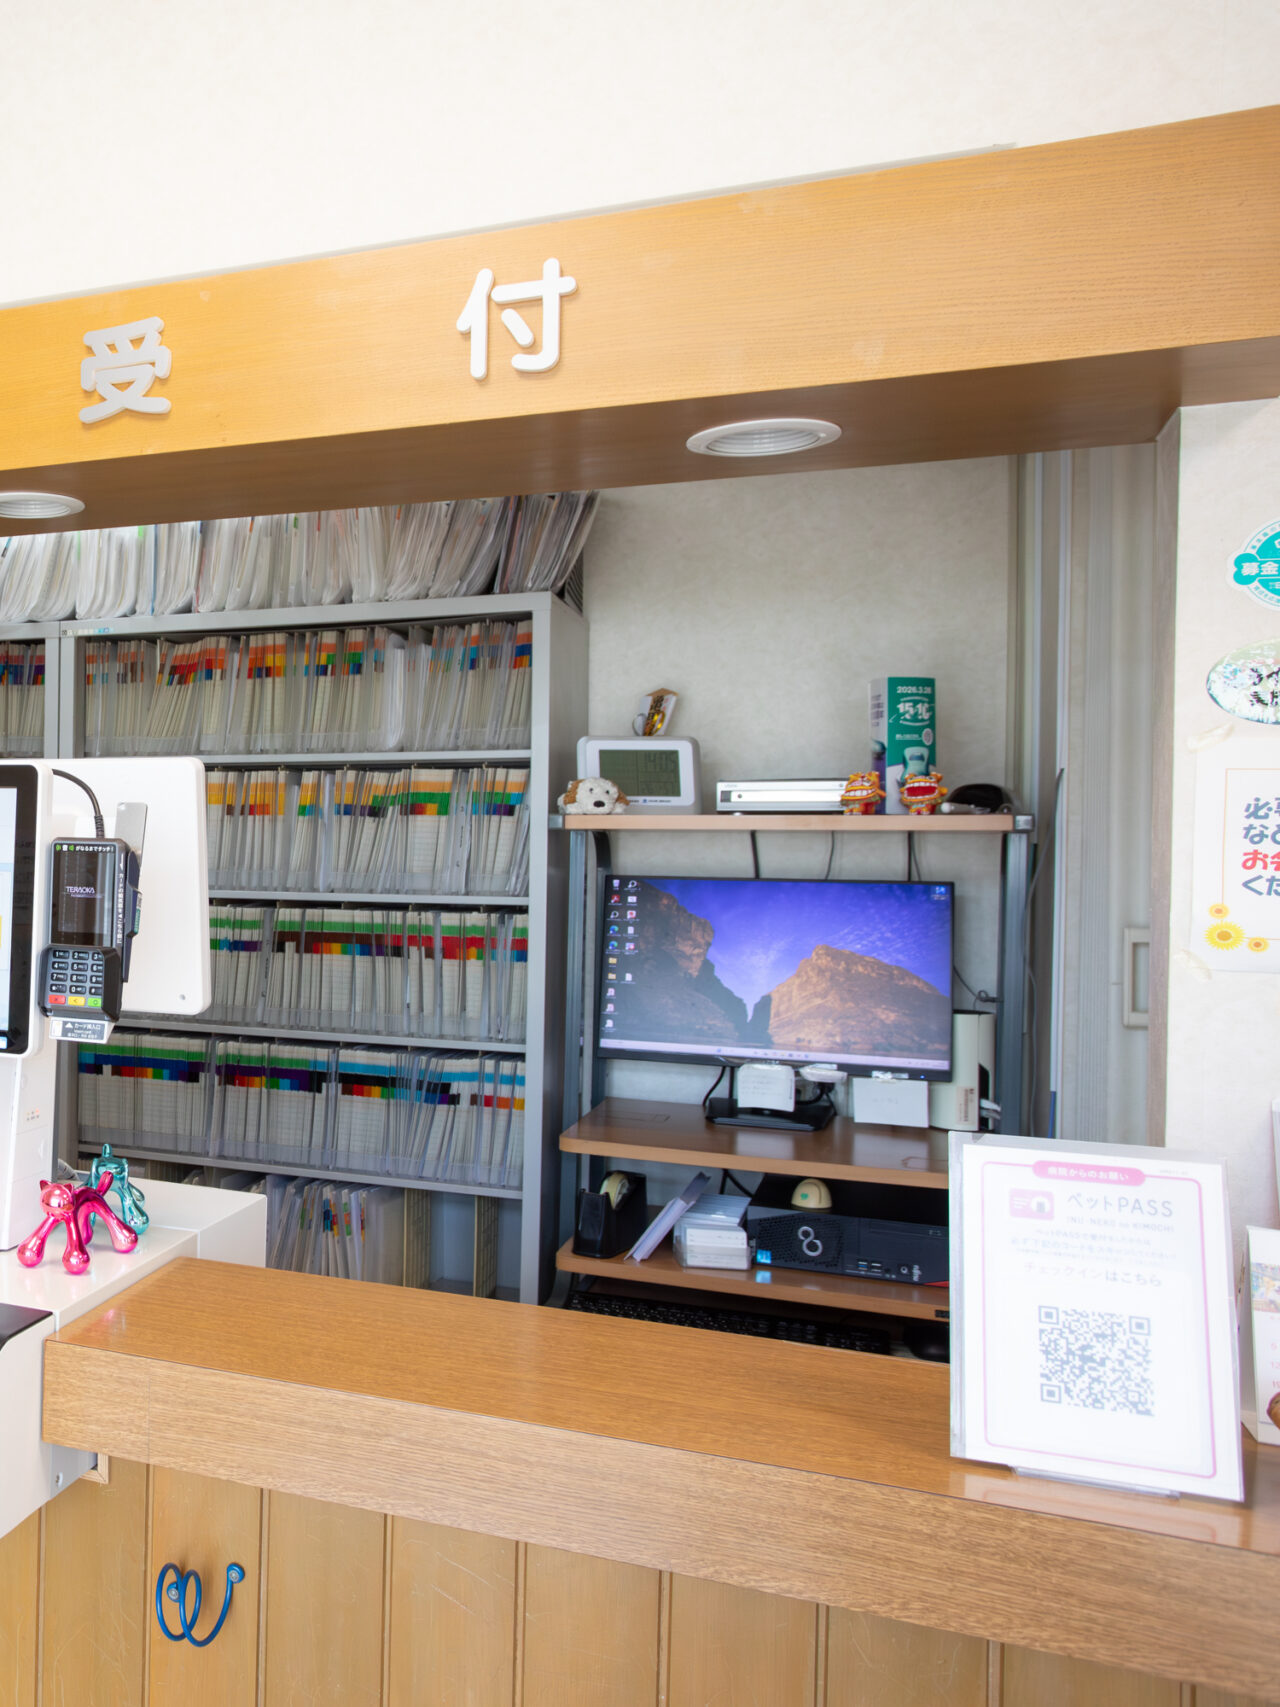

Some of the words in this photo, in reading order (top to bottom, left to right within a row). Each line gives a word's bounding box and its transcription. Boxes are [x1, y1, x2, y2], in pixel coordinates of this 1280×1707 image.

[1047, 1166, 1129, 1182] 病院からのお願い
[1067, 1192, 1173, 1218] ペットPASS
